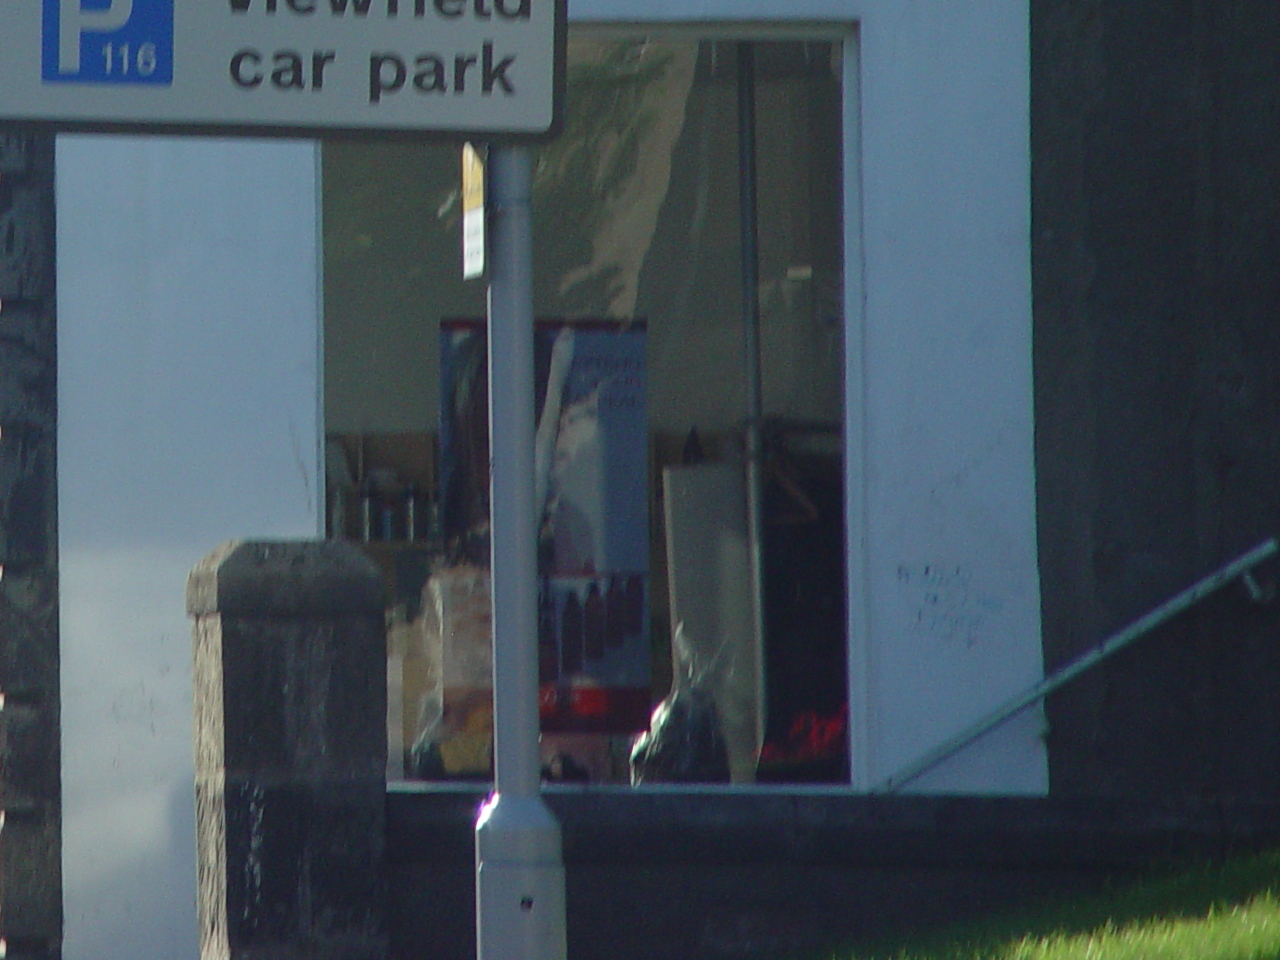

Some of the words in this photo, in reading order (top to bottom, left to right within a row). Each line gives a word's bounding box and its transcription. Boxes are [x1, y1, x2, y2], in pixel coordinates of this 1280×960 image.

[102, 42, 158, 77] 116
[229, 45, 336, 92] car
[368, 42, 518, 106] park
